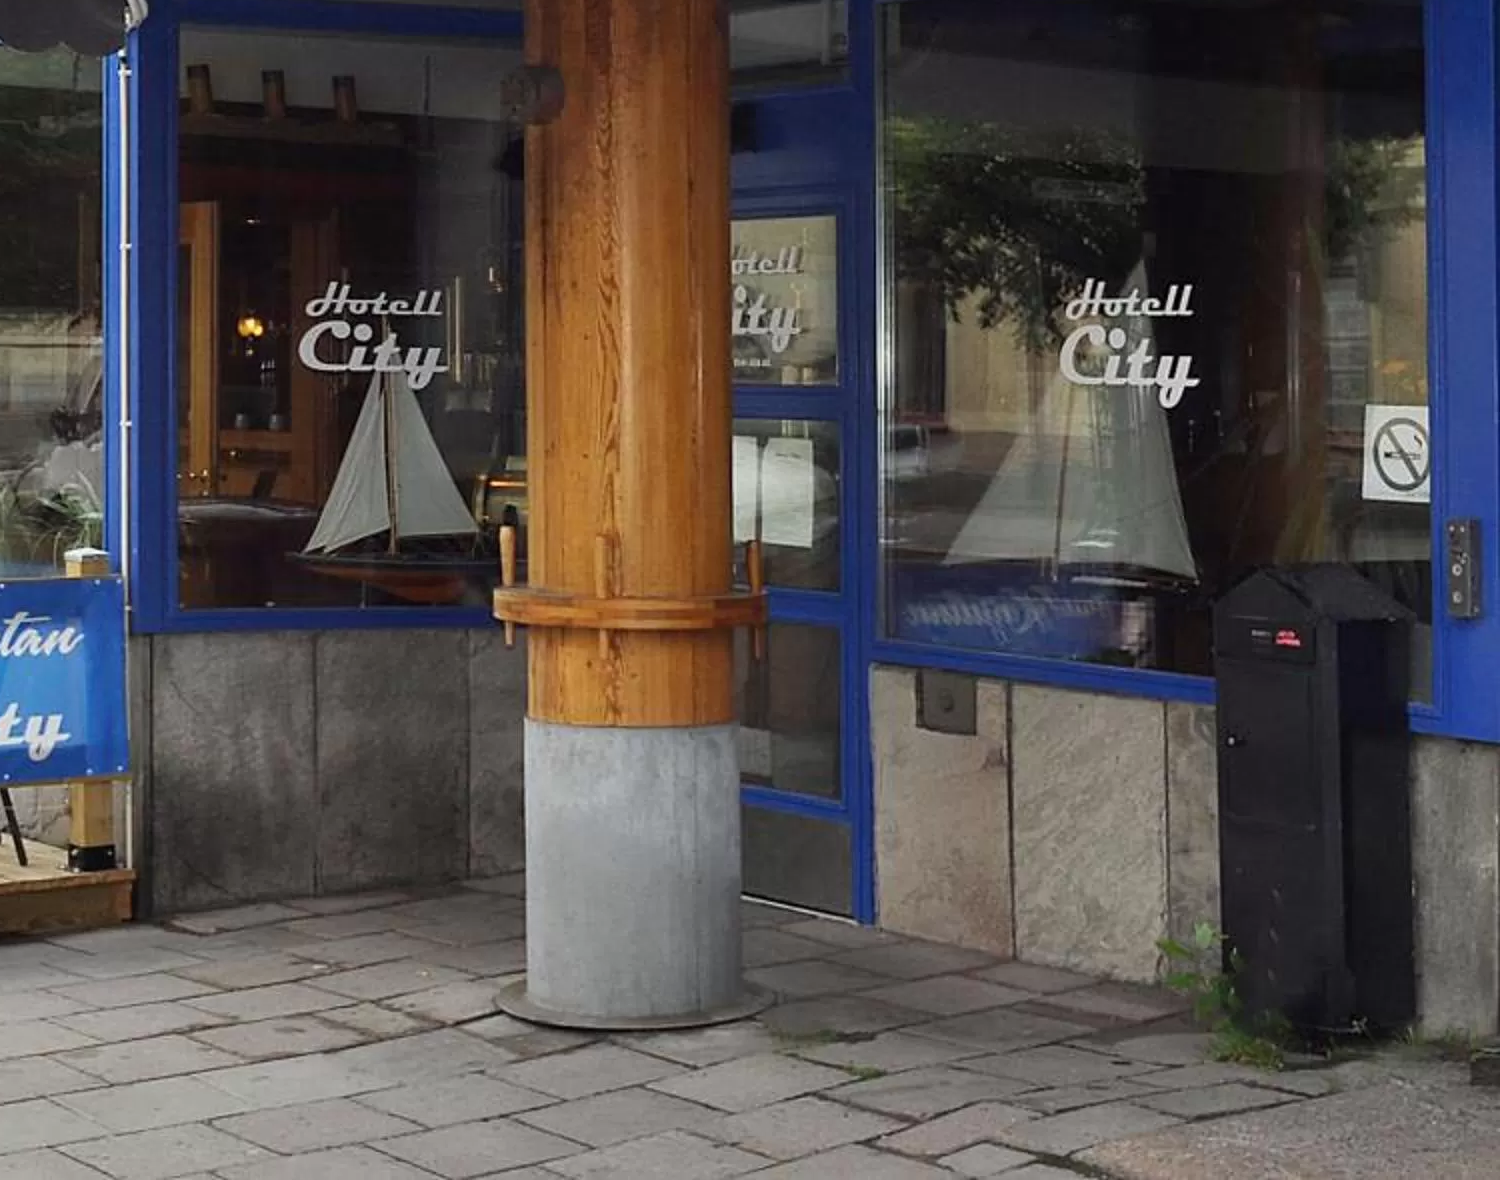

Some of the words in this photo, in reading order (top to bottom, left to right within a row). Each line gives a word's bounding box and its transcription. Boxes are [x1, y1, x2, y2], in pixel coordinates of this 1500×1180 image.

[731, 245, 798, 274] otell
[305, 281, 443, 317] Hotell
[731, 285, 801, 353] ity
[1065, 277, 1194, 320] Hotell
[298, 320, 449, 390] City
[1059, 324, 1200, 409] City
